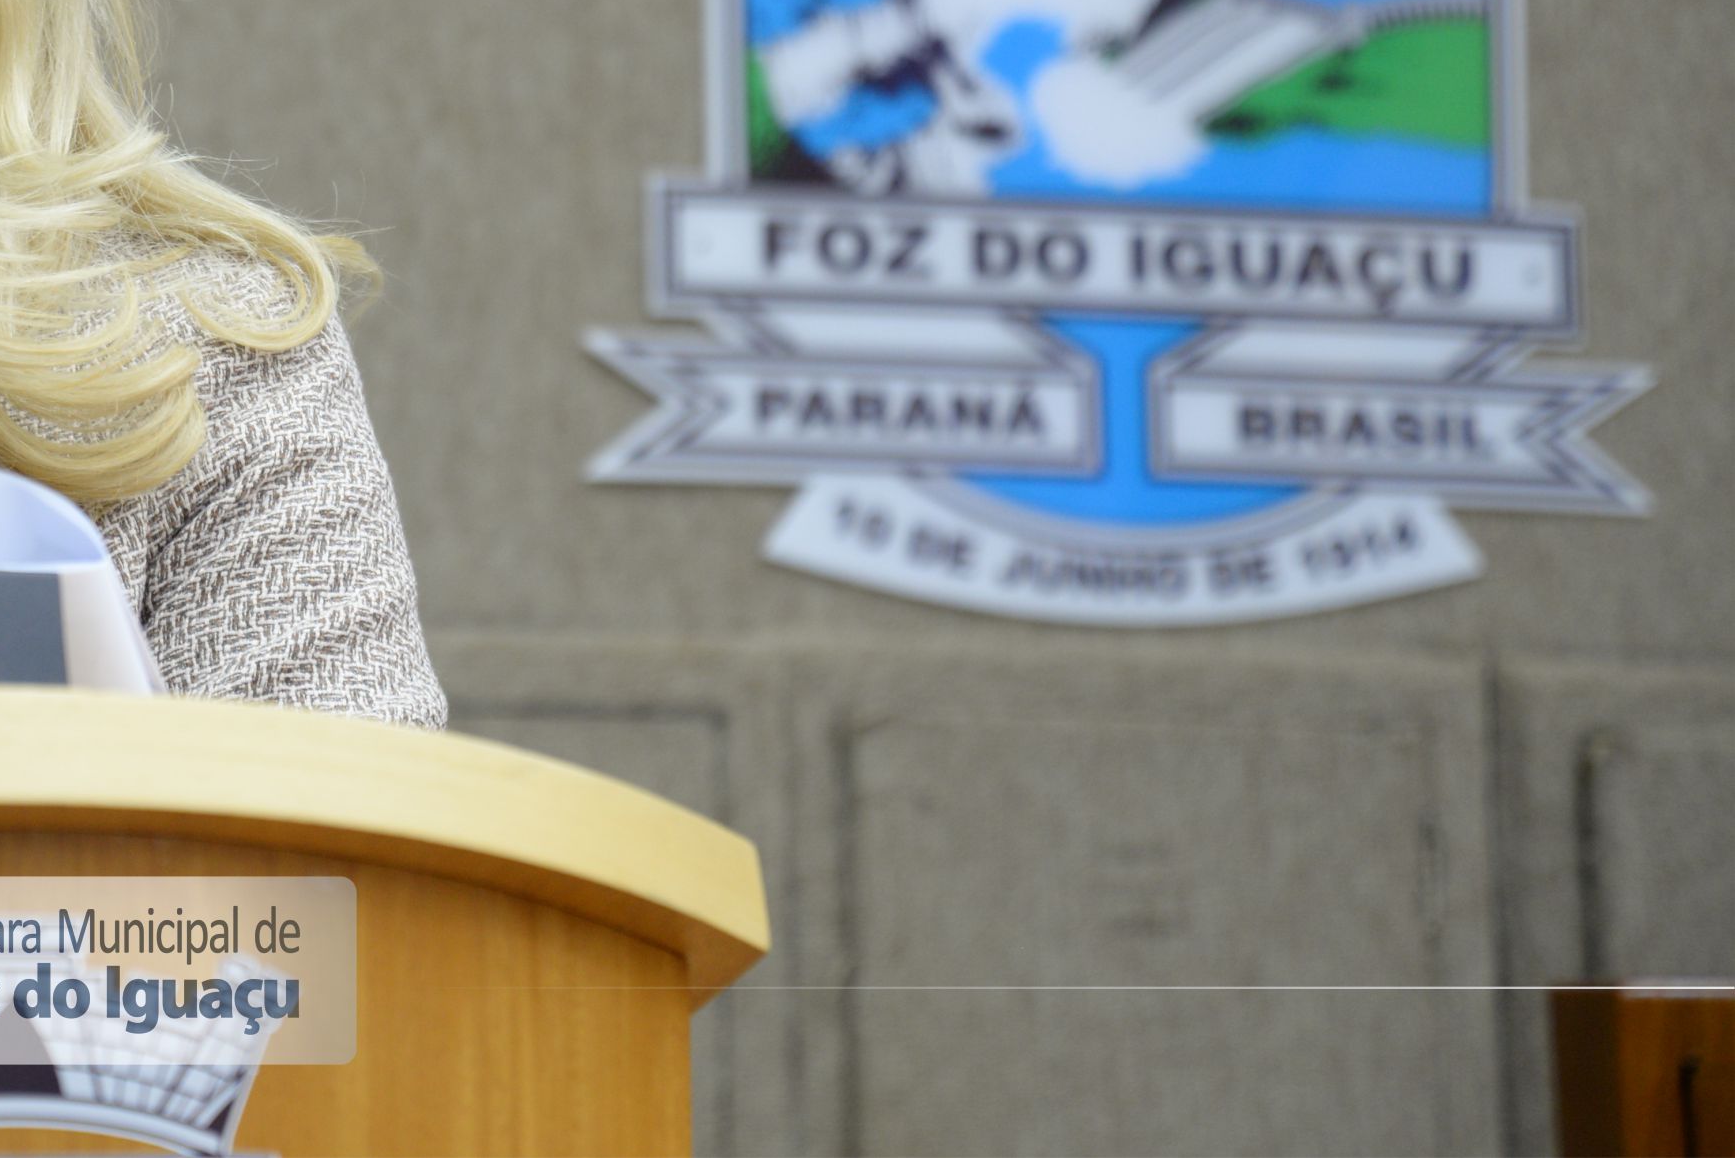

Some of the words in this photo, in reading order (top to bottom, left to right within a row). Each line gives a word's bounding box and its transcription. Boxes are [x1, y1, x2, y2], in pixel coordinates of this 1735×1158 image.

[761, 216, 936, 276] FOZ
[970, 224, 1089, 284] DO
[1128, 230, 1476, 314] IGUAÇU
[754, 377, 1046, 438] PARANÁ
[1236, 400, 1486, 452] BRASIL
